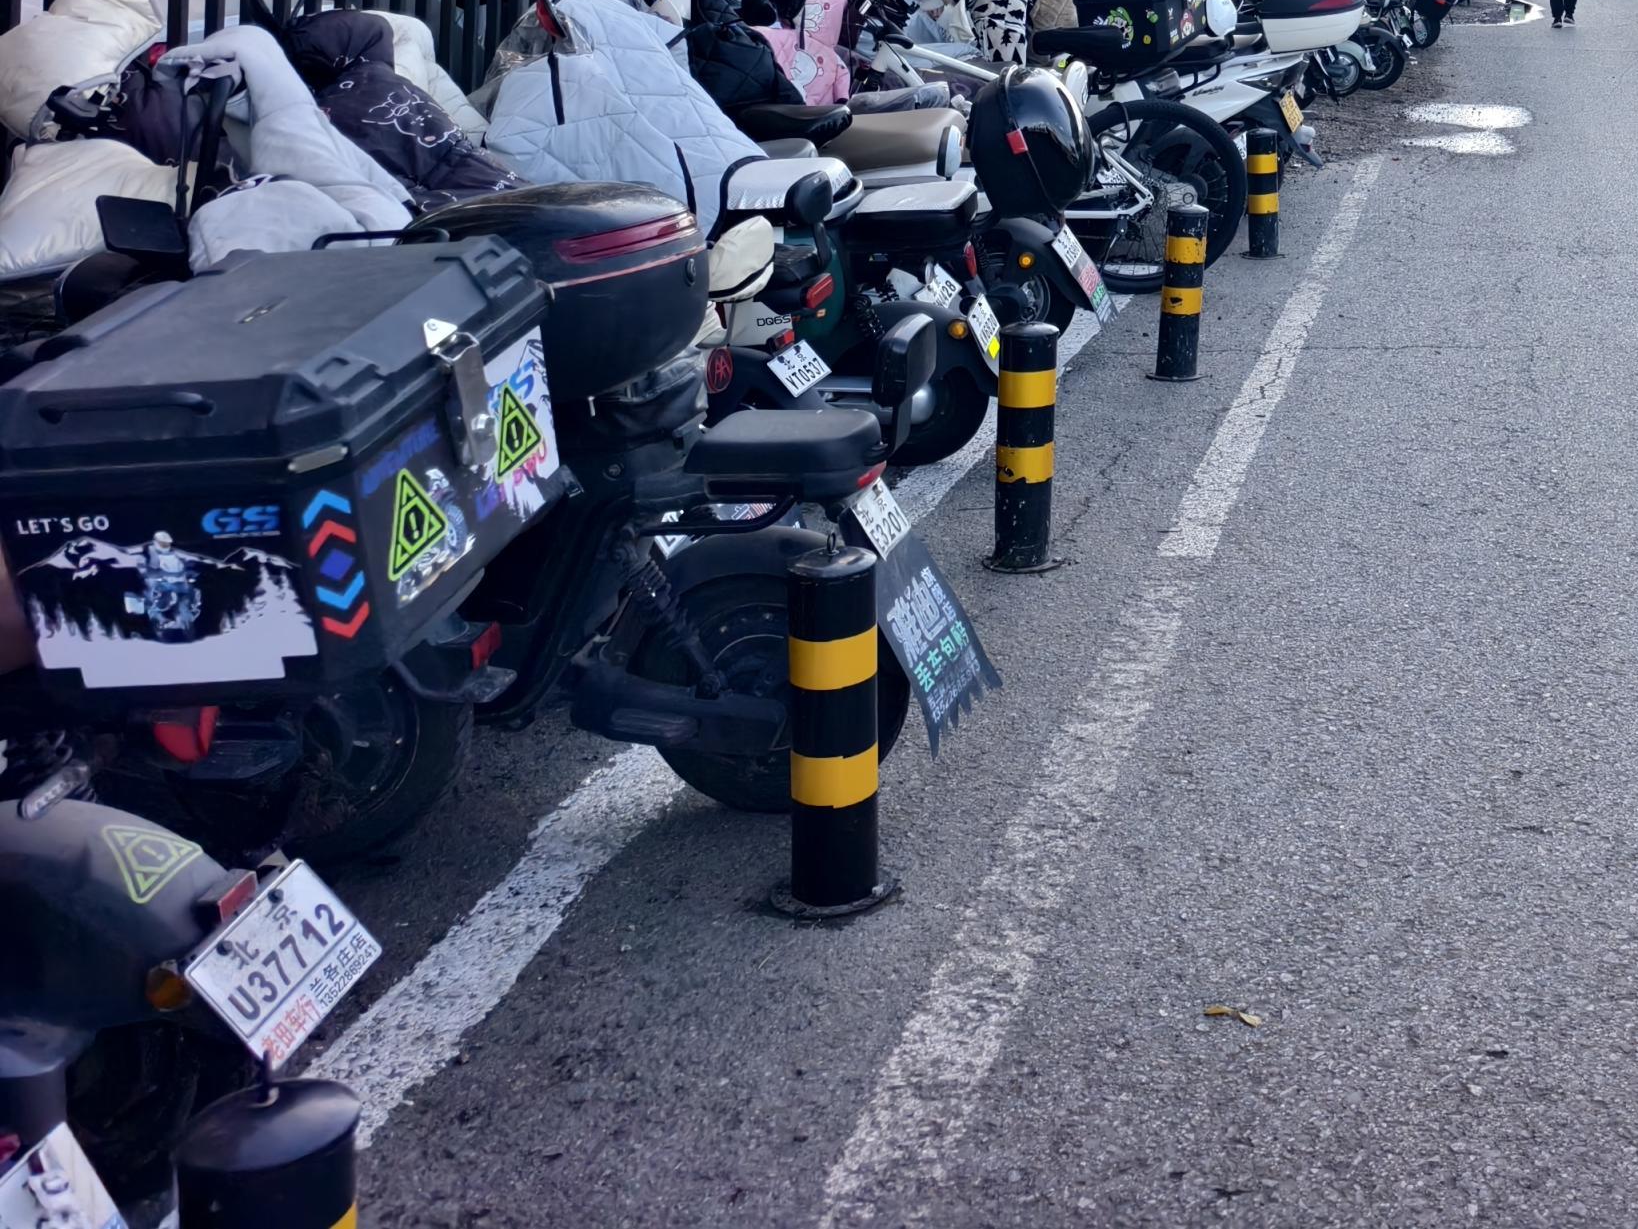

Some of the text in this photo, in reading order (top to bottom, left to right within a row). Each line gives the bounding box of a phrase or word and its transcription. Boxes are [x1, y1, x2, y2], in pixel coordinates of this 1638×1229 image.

[77, 515, 110, 532] GO
[227, 903, 346, 1021] U37712
[231, 903, 298, 970] 北京
[310, 933, 367, 998] 兰各庄店
